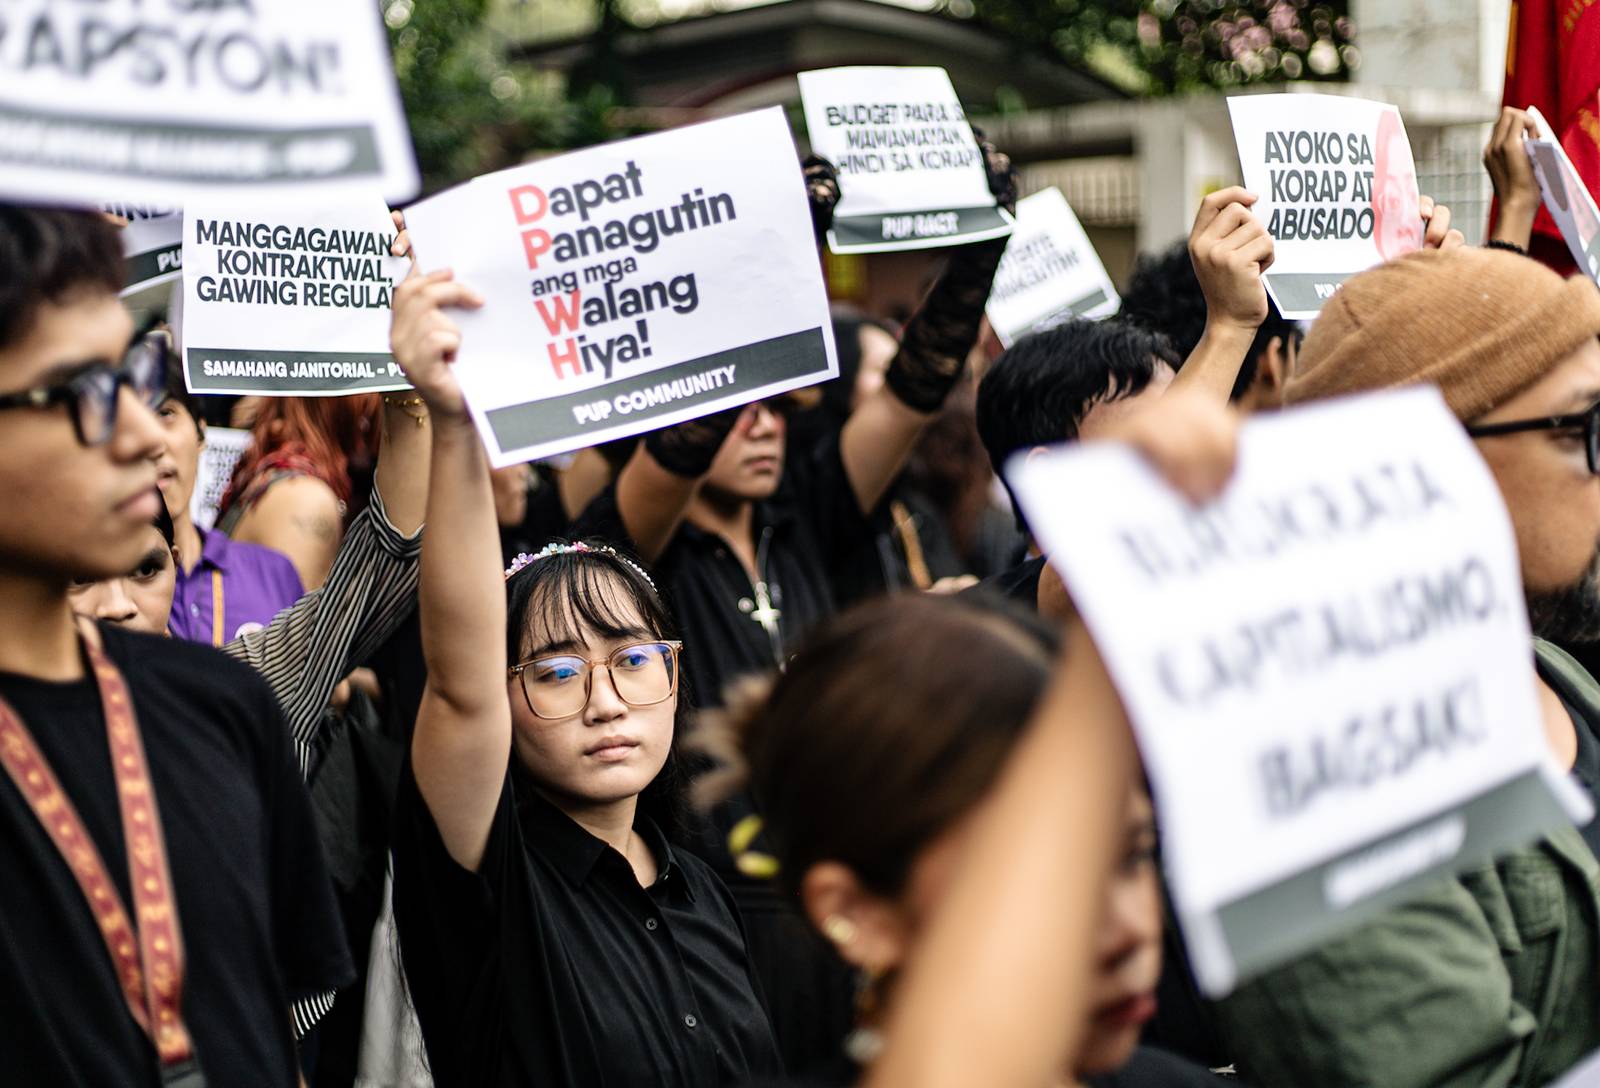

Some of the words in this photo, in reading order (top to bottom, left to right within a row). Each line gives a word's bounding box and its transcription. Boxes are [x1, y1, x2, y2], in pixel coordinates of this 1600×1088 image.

[0, 12, 348, 95] APSYON!
[825, 103, 898, 127] BUDGET
[903, 102, 950, 123] PARA
[891, 152, 913, 173] SA
[1264, 130, 1344, 165] AYOKO
[1346, 132, 1375, 166] SA
[507, 159, 644, 226] Dapat
[1269, 168, 1347, 203] KORAP
[1351, 170, 1375, 203] AT
[196, 218, 393, 257] MANGGAGAWAN
[520, 187, 737, 271] Panagutin
[881, 215, 913, 240] PUP
[1267, 207, 1375, 241] ABUSADO
[217, 248, 394, 288] KONTRAKTWAL,
[531, 271, 579, 296] ang
[584, 256, 638, 283] mga
[196, 276, 299, 306] GAWING
[533, 272, 700, 337] Walang
[203, 359, 288, 378] SAMAHANG
[289, 361, 376, 379] JANITORIAL
[546, 318, 653, 381] Hiya!
[572, 399, 613, 425] PUP
[613, 363, 737, 415] COMMUNITY
